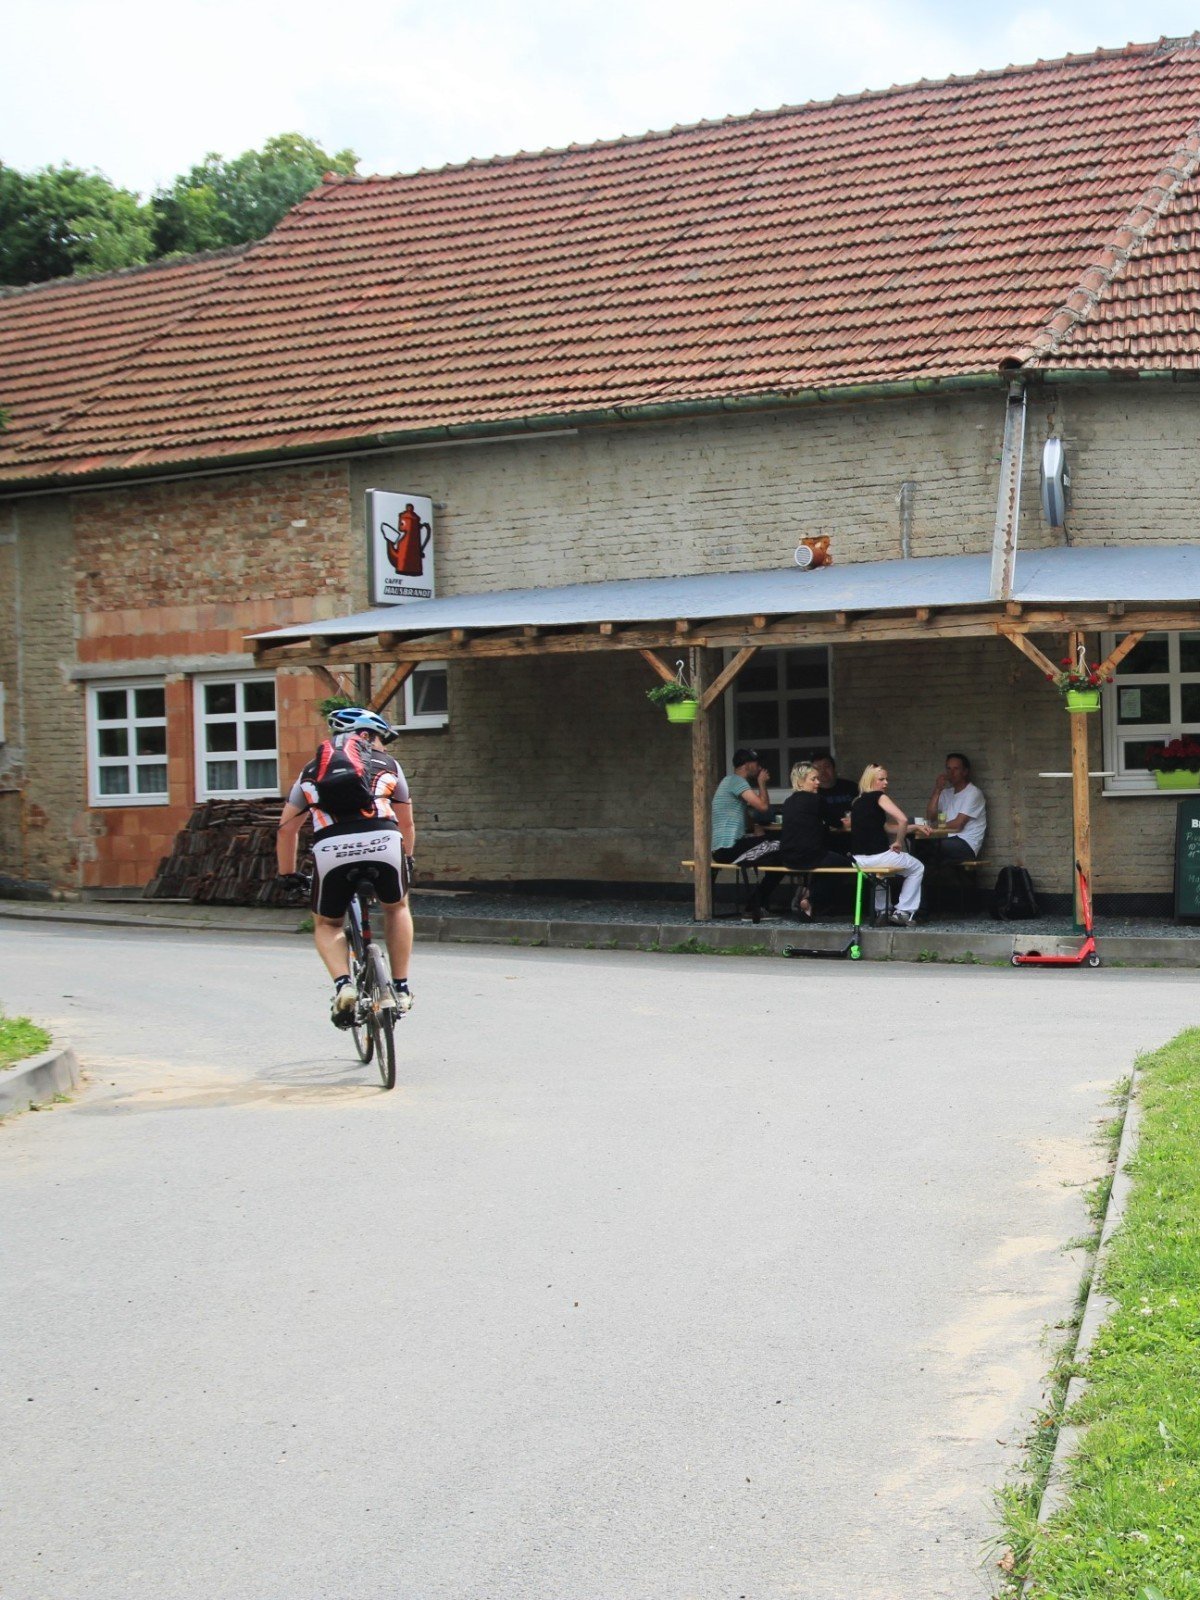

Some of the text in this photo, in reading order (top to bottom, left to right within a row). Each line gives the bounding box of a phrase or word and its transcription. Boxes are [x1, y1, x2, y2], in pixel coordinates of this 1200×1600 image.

[384, 586, 431, 597] HAUSBRANDT
[321, 835, 391, 852] CYKLOS
[335, 844, 387, 858] BRNO
